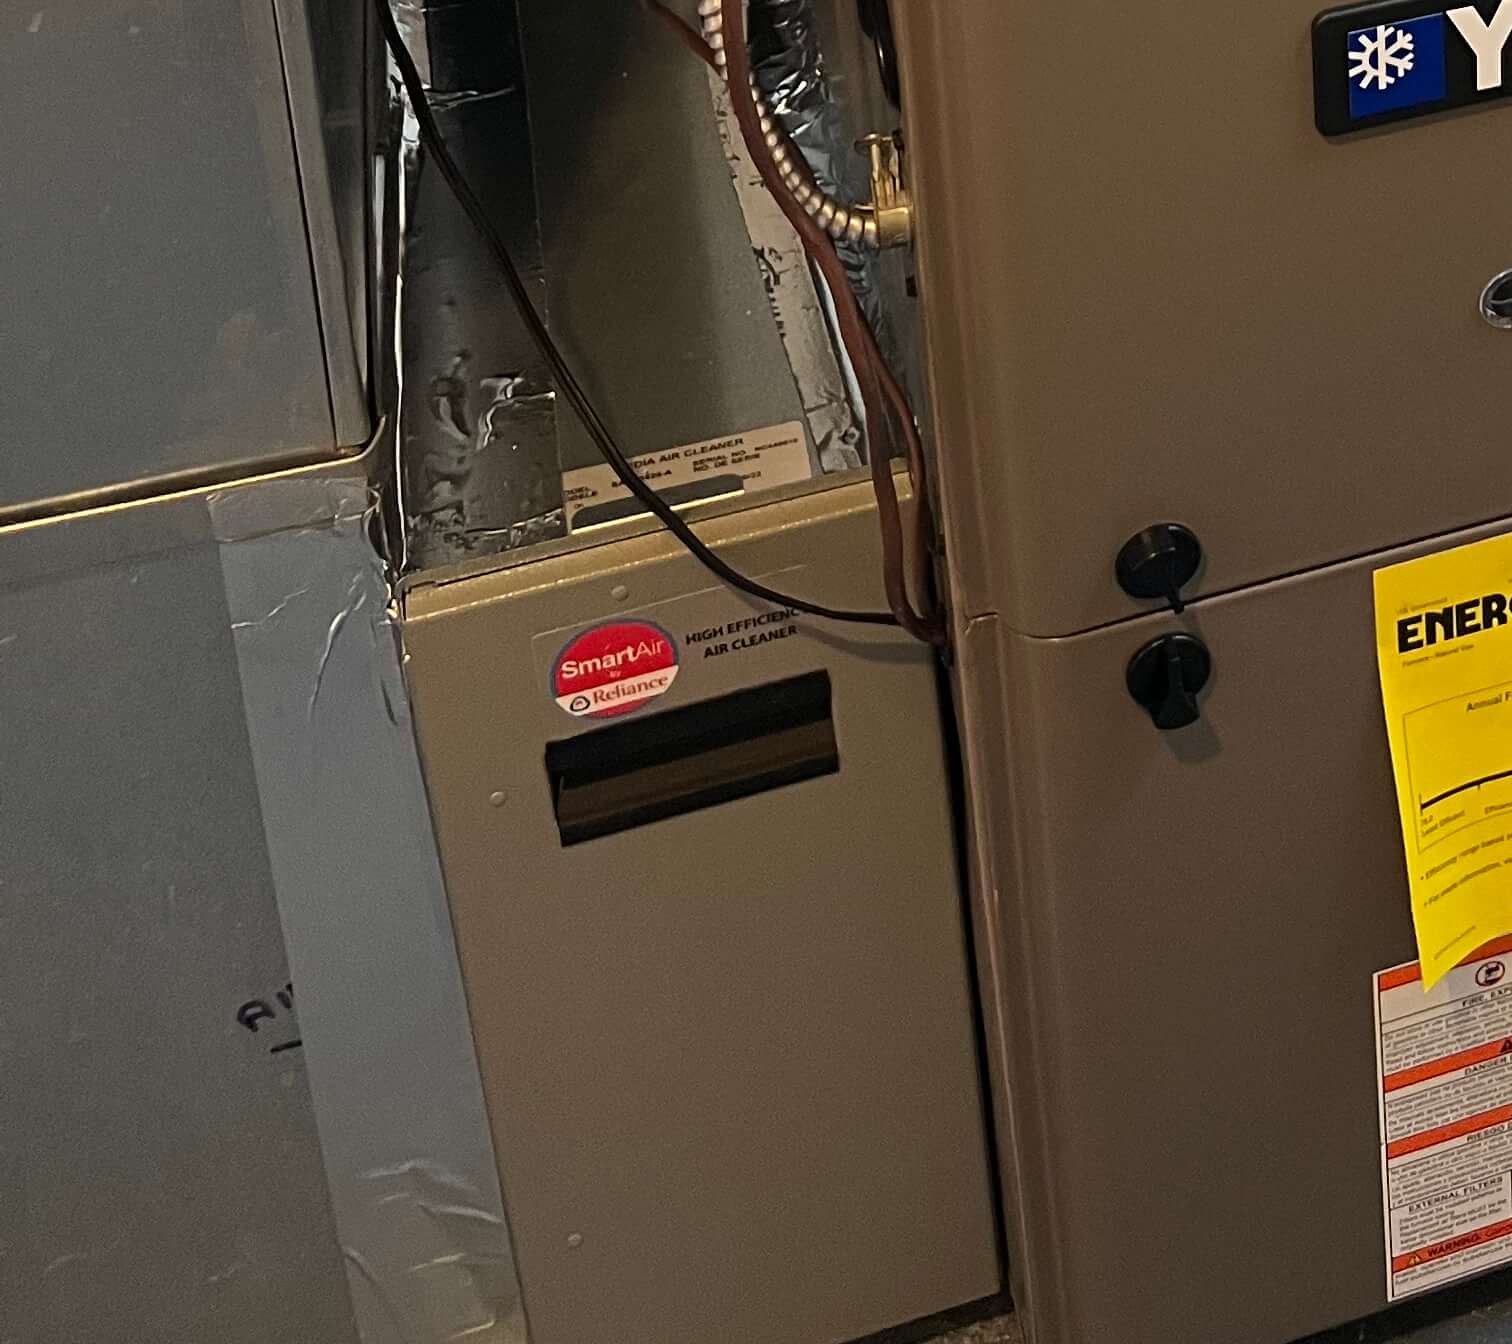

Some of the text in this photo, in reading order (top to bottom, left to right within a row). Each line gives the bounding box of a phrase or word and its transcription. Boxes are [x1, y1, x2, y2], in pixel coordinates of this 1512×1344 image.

[683, 438, 744, 457] CLEANER
[685, 608, 800, 645] HIGH EFFICIENC
[703, 625, 797, 659] AIR CLEANER
[561, 640, 665, 679] SmartAir
[592, 674, 668, 705] Reliance
[1466, 694, 1502, 712] Annual
[1408, 1176, 1503, 1213] EXTERNAL FILTERS
